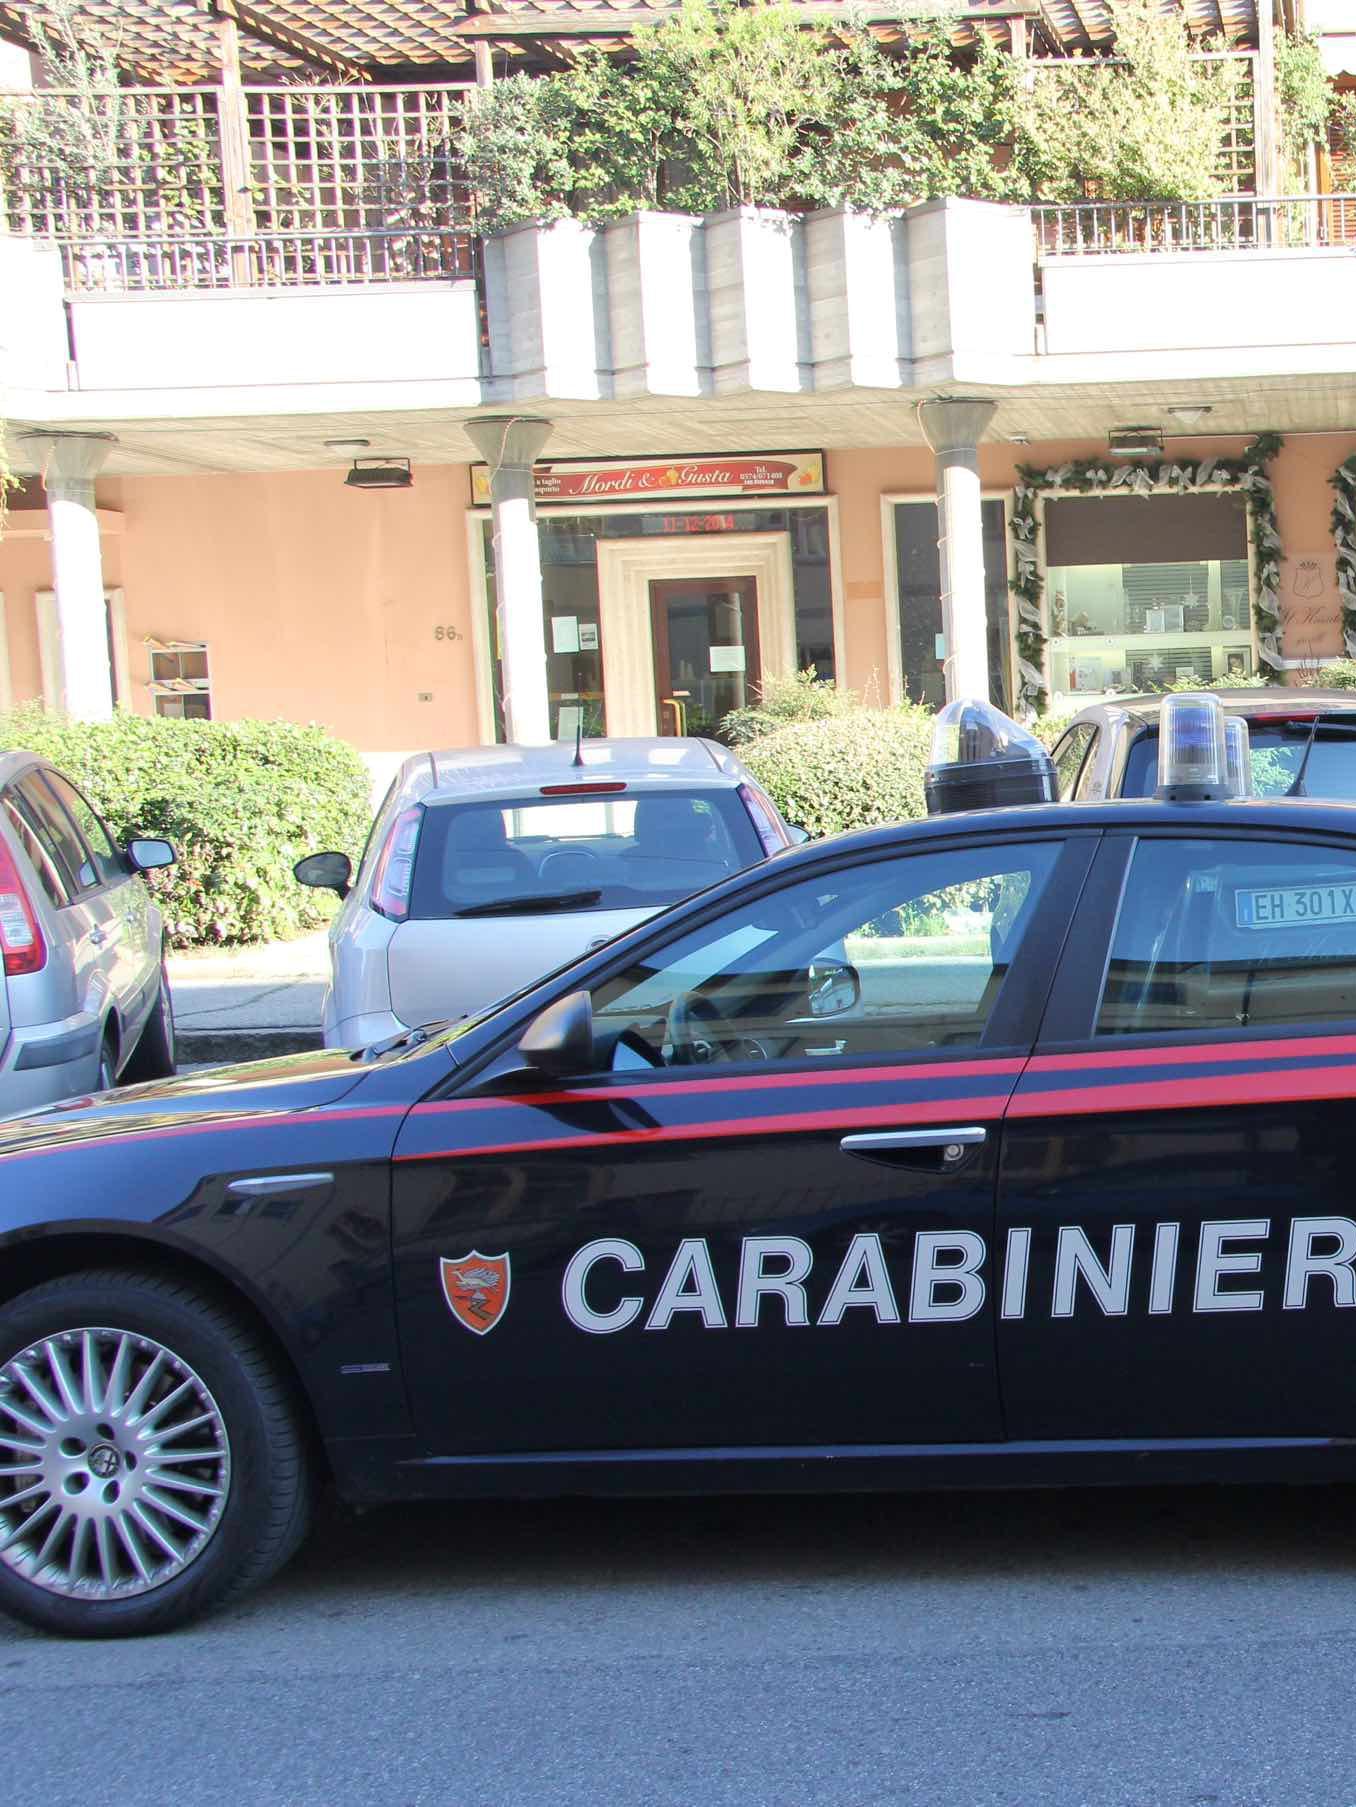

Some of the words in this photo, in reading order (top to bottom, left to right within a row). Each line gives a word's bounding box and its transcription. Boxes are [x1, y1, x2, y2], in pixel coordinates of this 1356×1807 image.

[569, 472, 633, 495] Mordi
[638, 473, 656, 488] &
[677, 465, 733, 485] Gusta
[1253, 893, 1285, 921] EH
